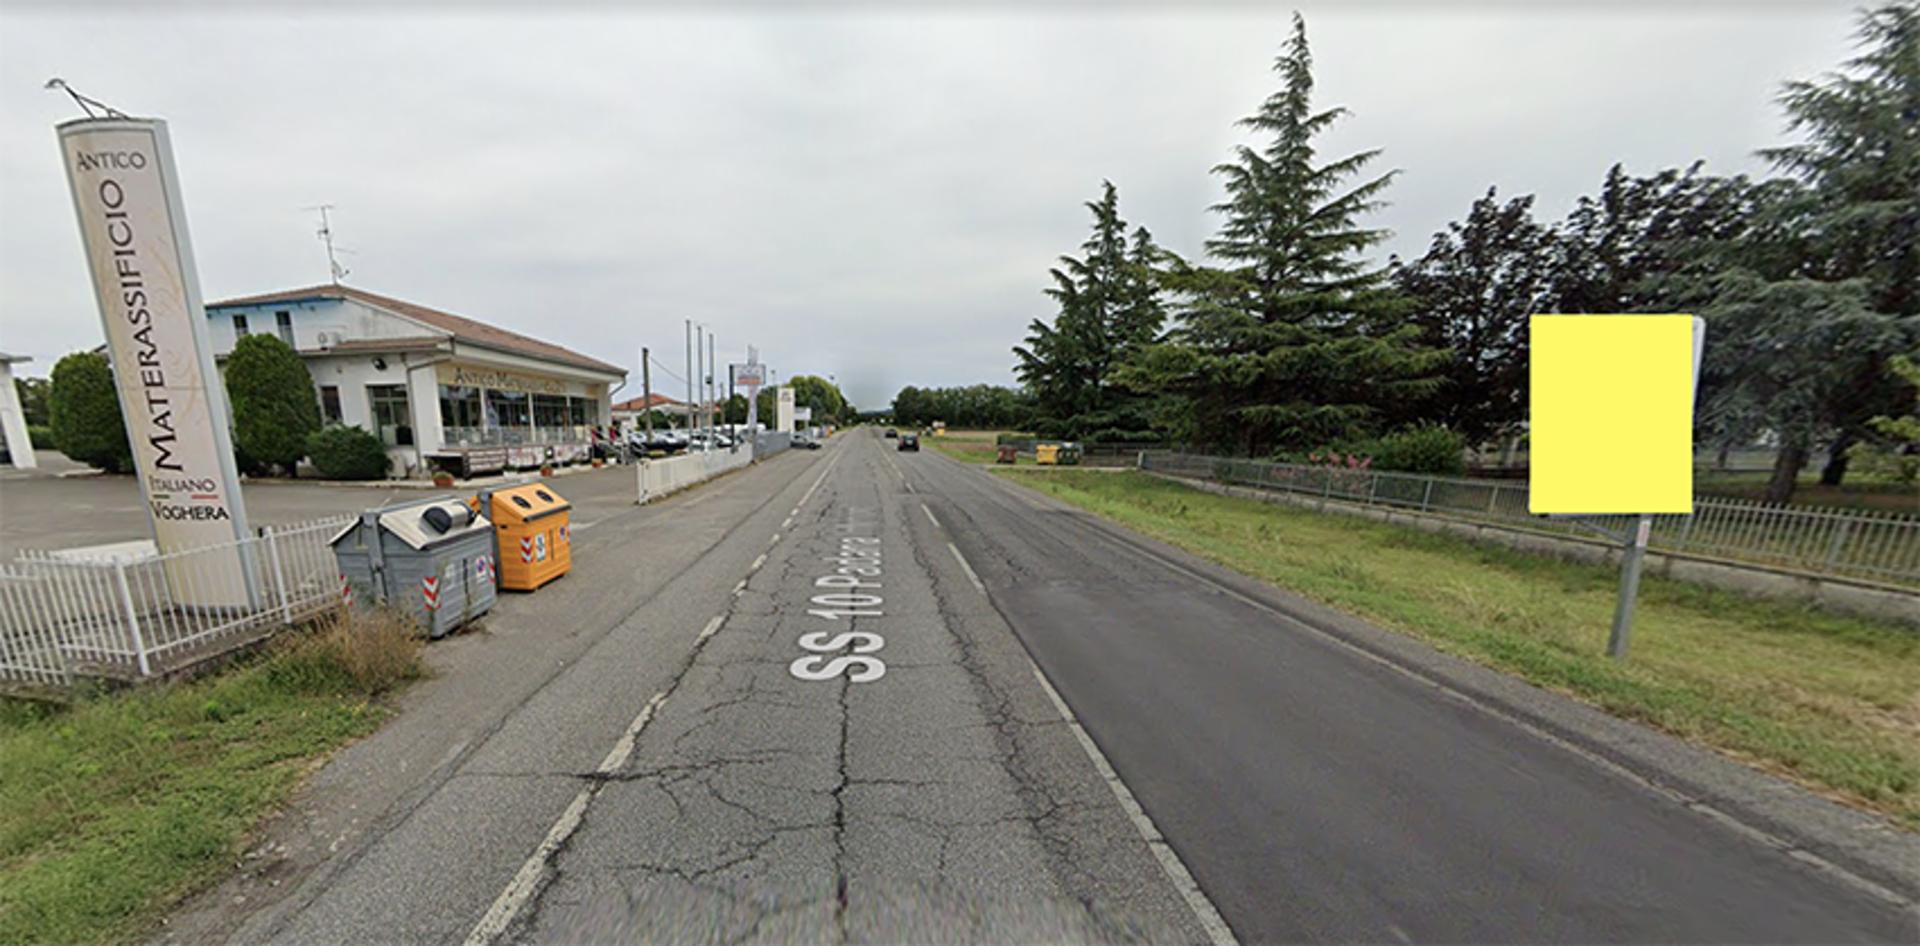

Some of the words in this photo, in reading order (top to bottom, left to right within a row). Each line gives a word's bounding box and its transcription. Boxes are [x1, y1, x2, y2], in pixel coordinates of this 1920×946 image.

[76, 151, 147, 171] ANTICO
[99, 179, 184, 472] MATERASSIFICIO
[149, 475, 216, 493] ITALIANO
[150, 500, 229, 520] VOGHERA
